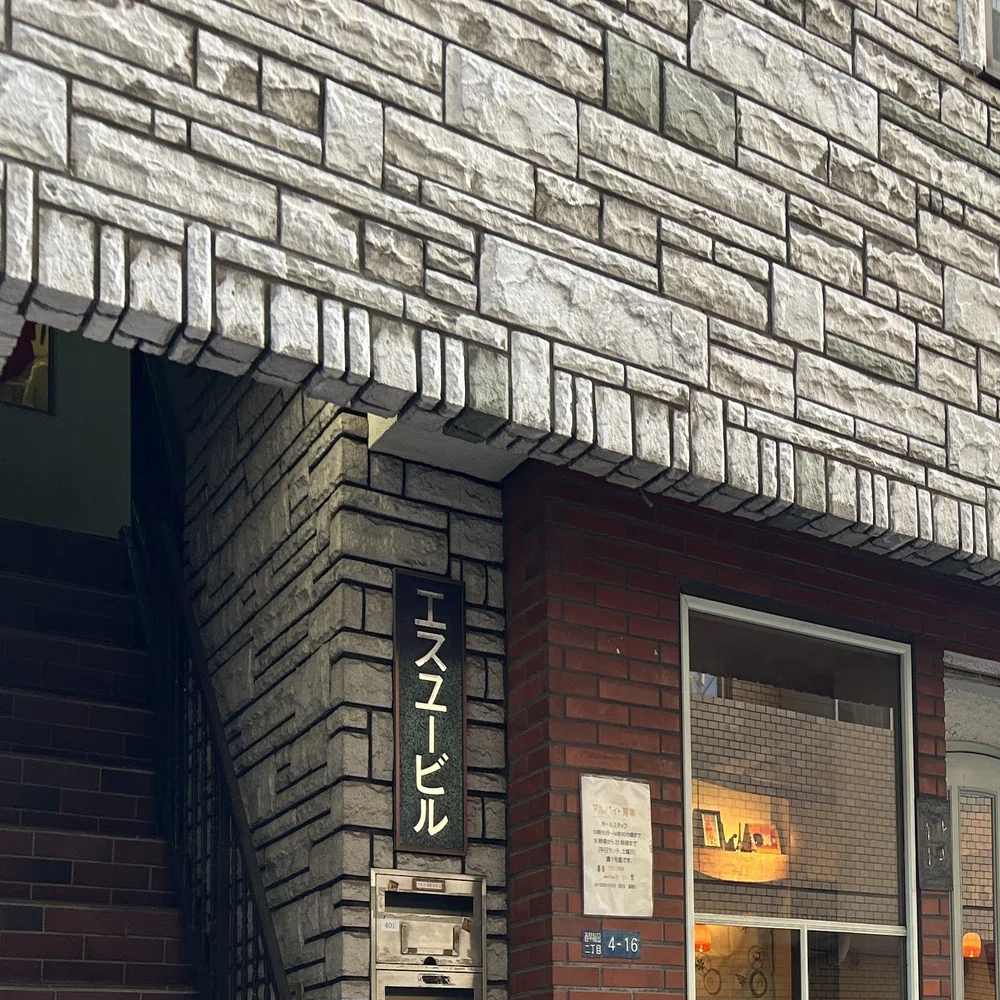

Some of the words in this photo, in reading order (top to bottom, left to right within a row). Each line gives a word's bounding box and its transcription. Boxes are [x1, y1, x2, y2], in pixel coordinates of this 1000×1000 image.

[413, 588, 448, 837] エスユービル
[607, 936, 638, 953] 4-16
